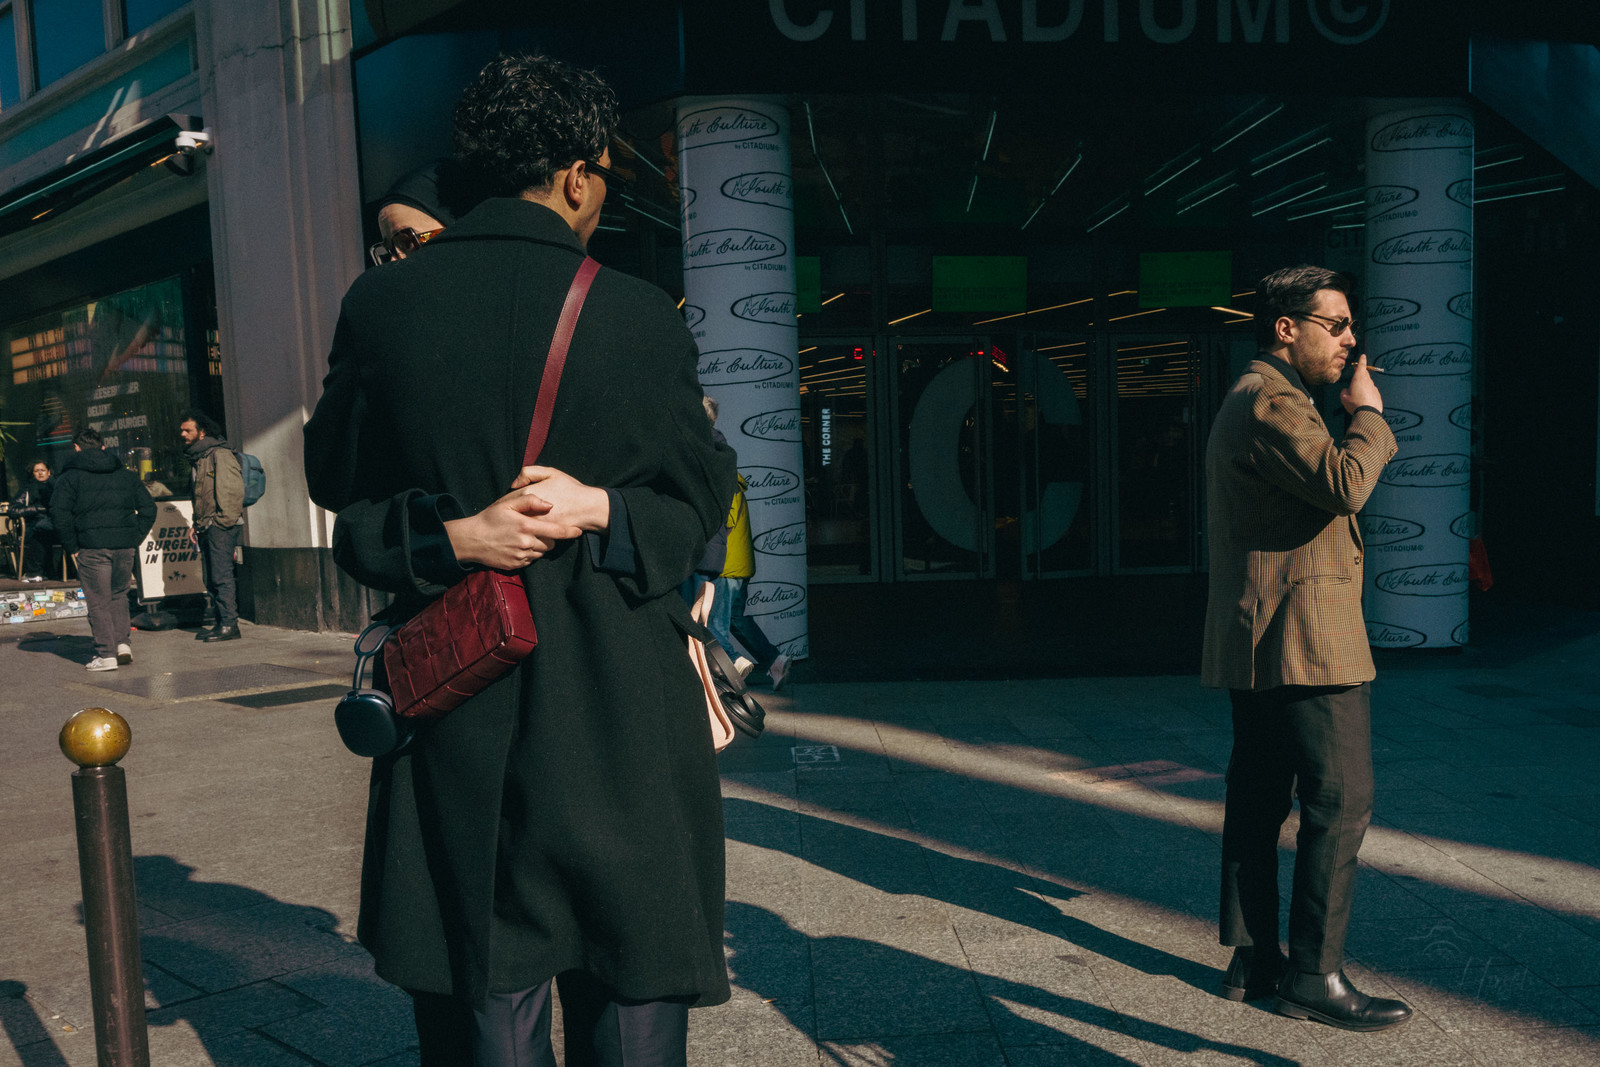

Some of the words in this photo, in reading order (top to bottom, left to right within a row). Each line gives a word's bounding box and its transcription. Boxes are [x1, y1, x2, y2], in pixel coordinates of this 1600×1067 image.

[706, 113, 768, 134] Culture
[717, 235, 776, 254] Culture
[726, 354, 784, 374] Culture
[821, 408, 831, 446] CORNER
[822, 447, 831, 467] THE
[158, 526, 189, 539] BEST
[145, 553, 159, 564] IN
[163, 551, 199, 564] TOWN
[746, 586, 799, 606] Culture
